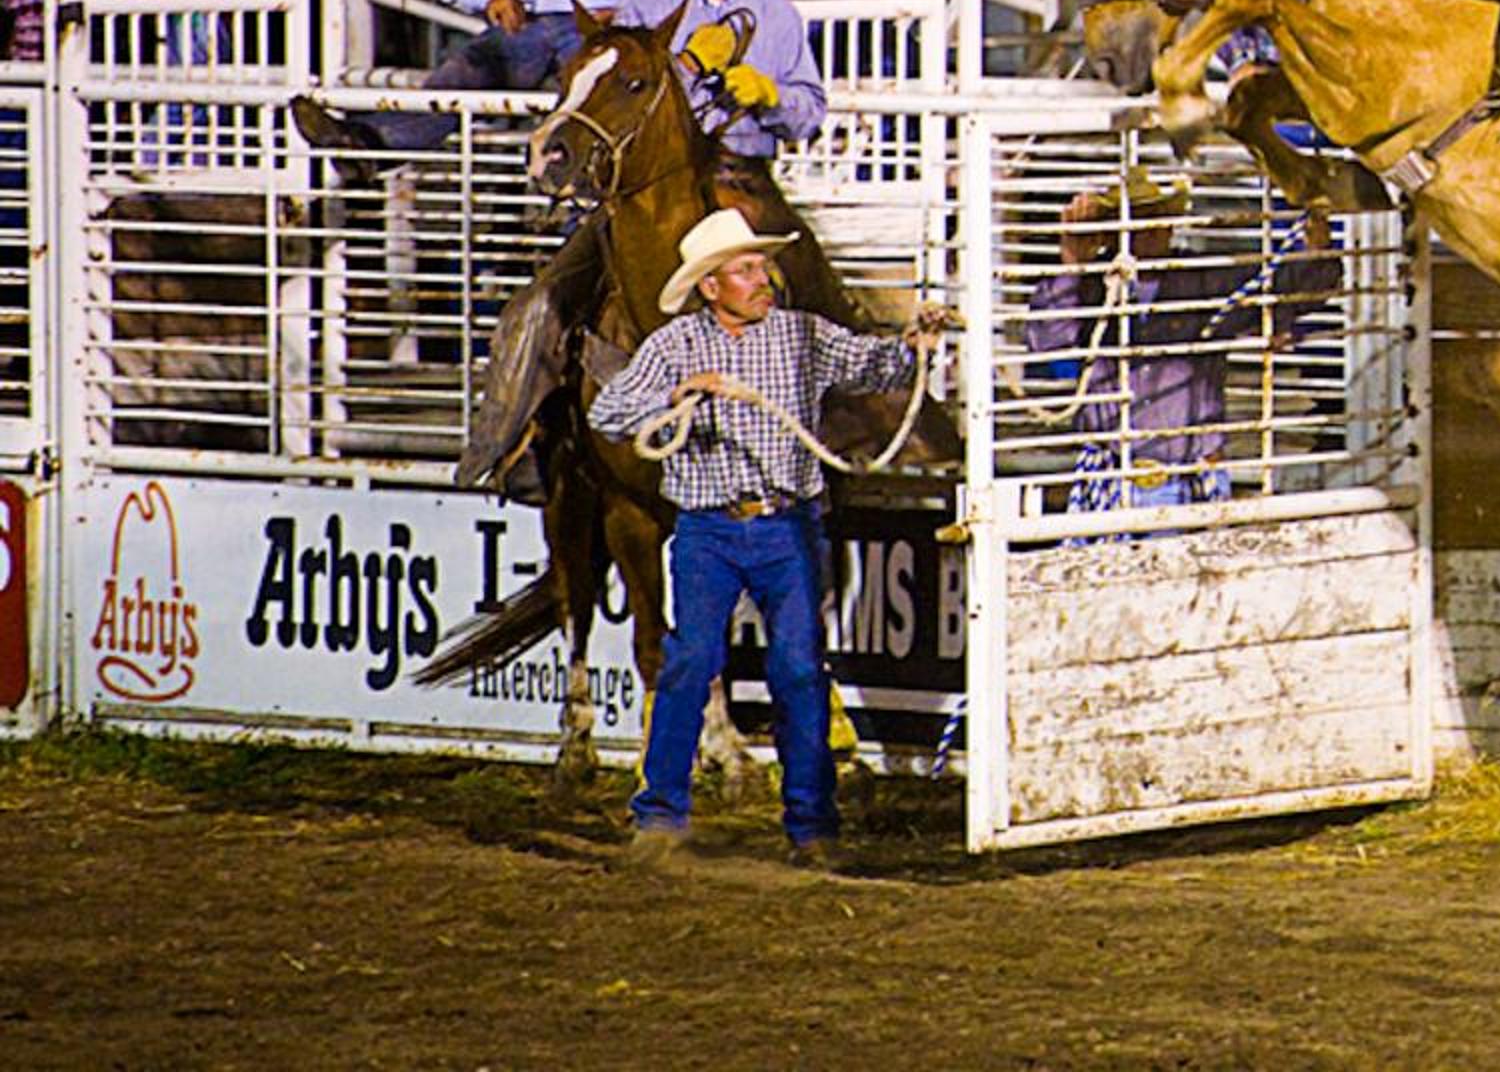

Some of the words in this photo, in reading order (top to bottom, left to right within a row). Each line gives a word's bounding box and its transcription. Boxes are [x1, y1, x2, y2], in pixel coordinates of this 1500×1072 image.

[91, 577, 200, 675] Arby's
[247, 514, 440, 690] Arby's
[469, 645, 634, 727] Interchnge
